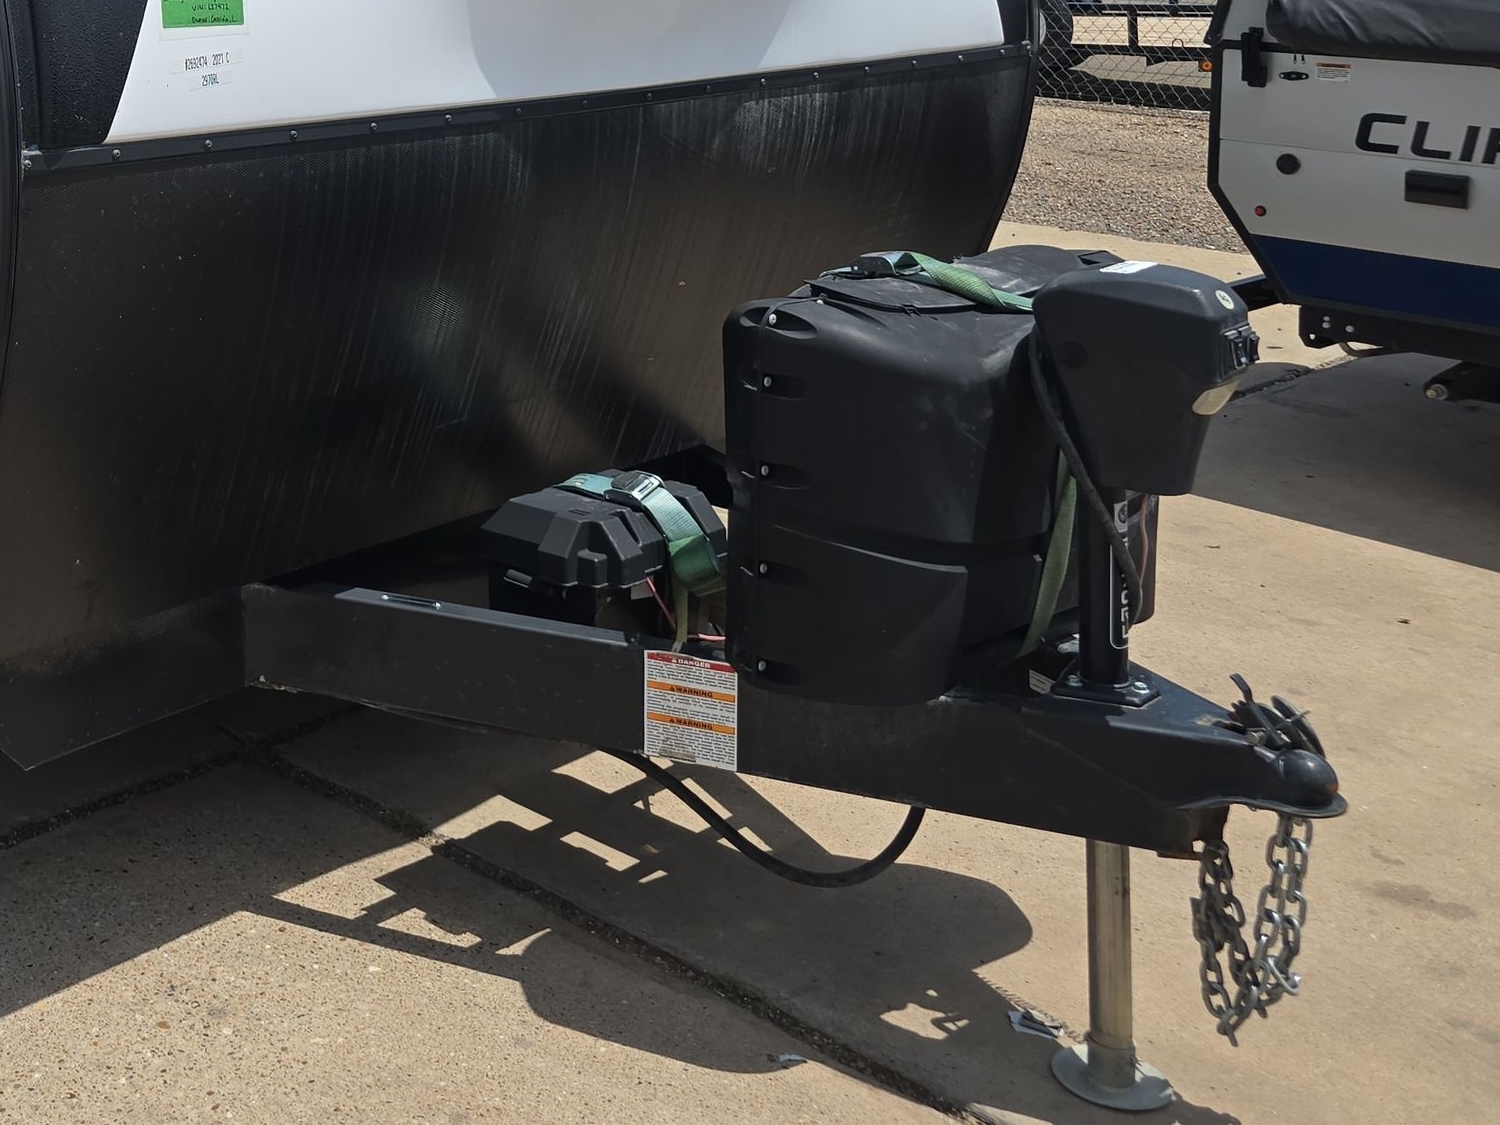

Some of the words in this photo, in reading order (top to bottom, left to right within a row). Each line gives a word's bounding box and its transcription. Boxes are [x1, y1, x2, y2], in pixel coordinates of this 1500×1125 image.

[678, 658, 711, 668] DANGER
[677, 685, 713, 698] WARNING
[677, 717, 713, 730] WARNING
